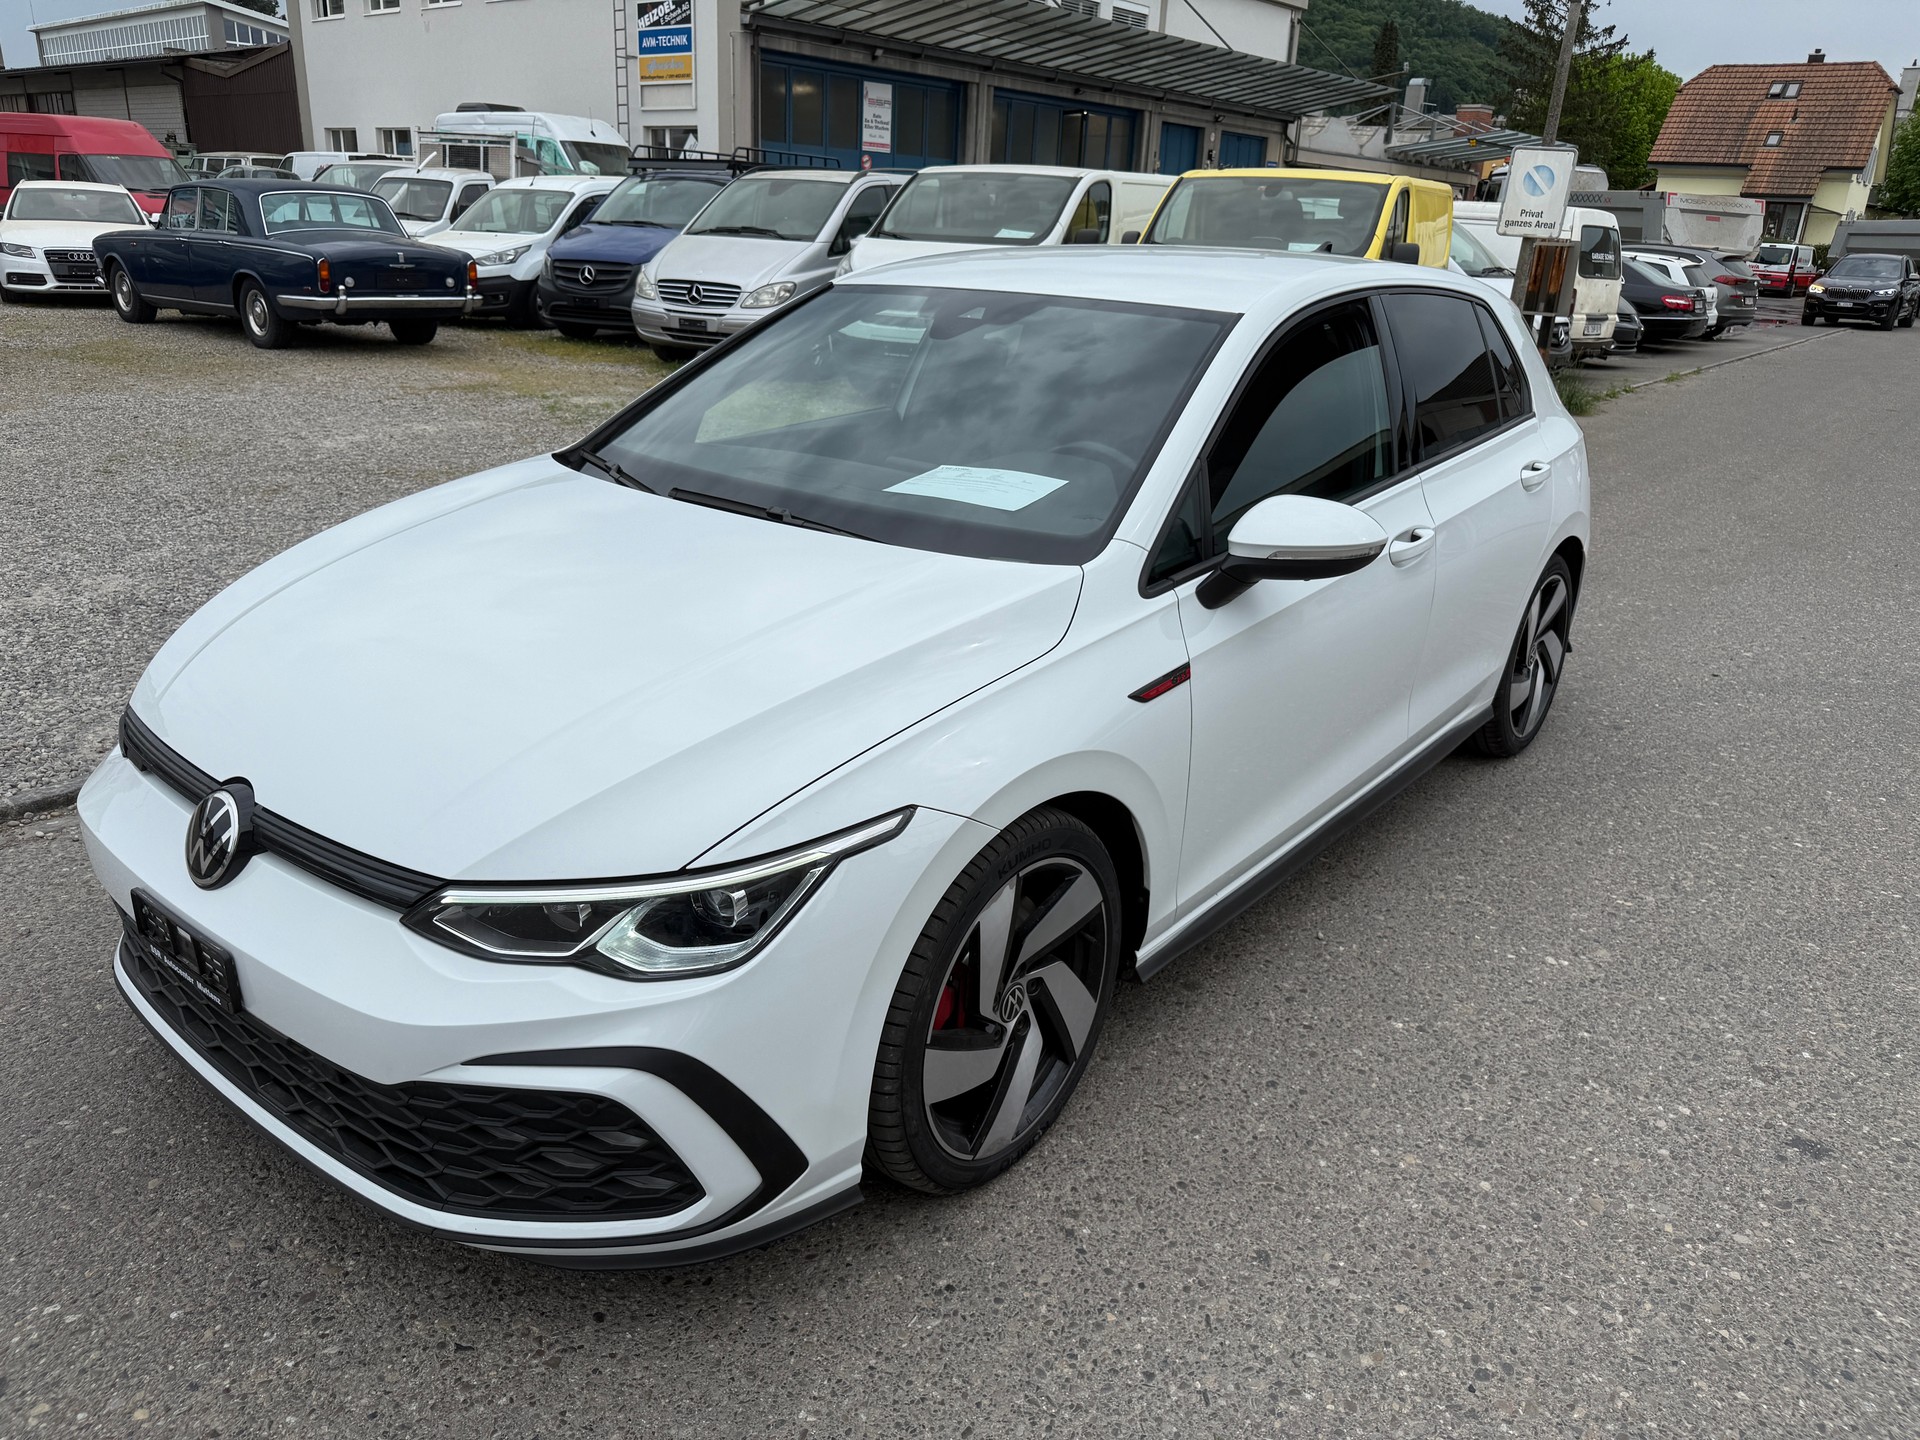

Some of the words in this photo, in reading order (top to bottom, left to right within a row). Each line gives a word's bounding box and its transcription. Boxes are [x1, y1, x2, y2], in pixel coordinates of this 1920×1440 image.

[638, 0, 675, 29] HEIZOEL
[642, 35, 688, 48] AVM-TECHNIK
[1520, 209, 1544, 218] Privat
[1504, 219, 1532, 228] ganzes
[1534, 220, 1556, 230] Areal
[998, 838, 1052, 880] KUMHO
